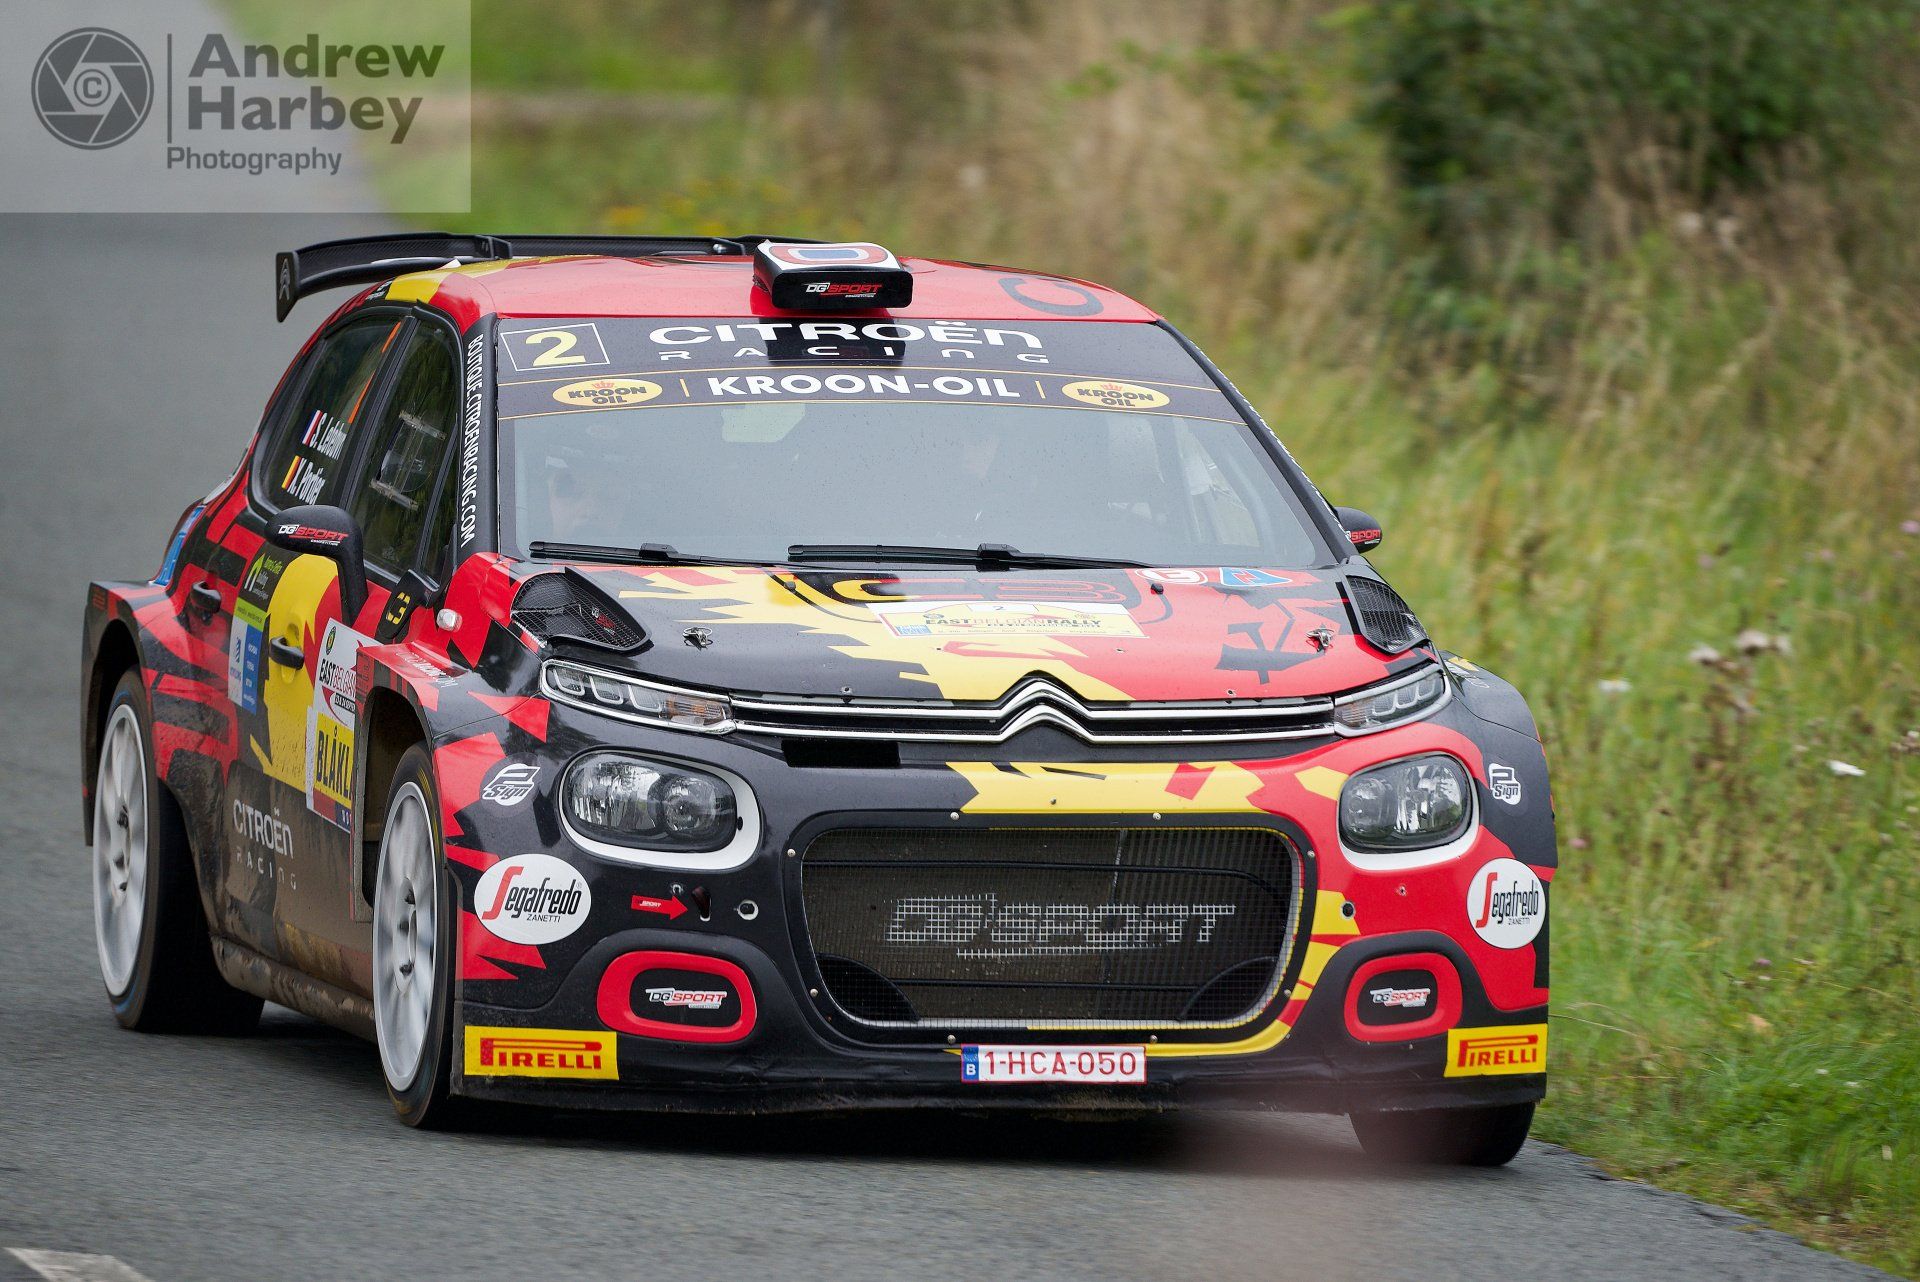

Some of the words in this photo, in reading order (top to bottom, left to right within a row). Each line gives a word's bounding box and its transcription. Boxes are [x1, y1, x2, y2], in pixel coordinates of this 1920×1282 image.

[525, 330, 587, 367] 2
[659, 347, 1050, 364] RACING
[567, 386, 647, 399] KROON
[707, 375, 1021, 398] KROON-OIL
[1077, 388, 1154, 401] KROON
[592, 396, 628, 405] OIL
[1101, 397, 1136, 407] OIL
[316, 725, 352, 801] BLÅKL
[482, 866, 582, 920] Segafredo
[1475, 872, 1539, 928] Segafredo
[527, 914, 561, 923] ZANETTI
[480, 1037, 603, 1070] PIRELLI
[965, 1063, 977, 1076] B
[984, 1051, 1136, 1076] 1-HCA-050
[1458, 1035, 1539, 1068] PIRELLI
